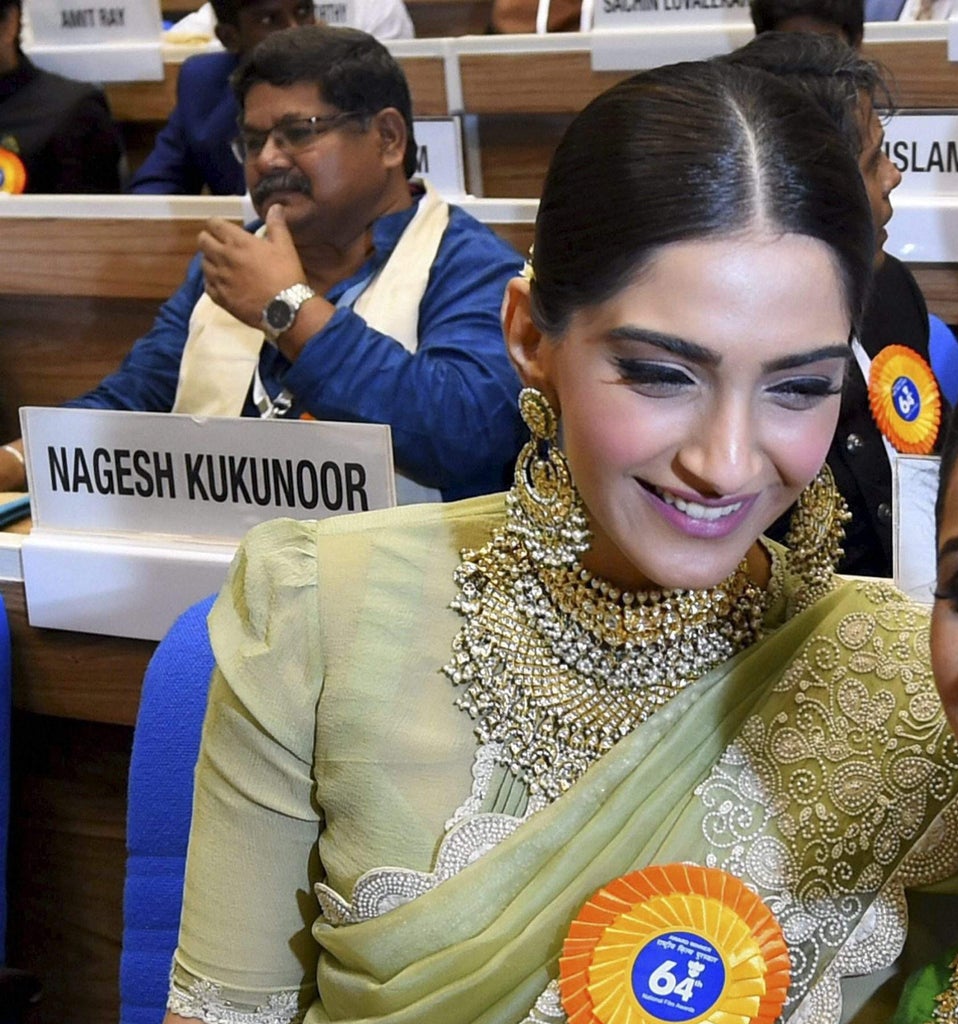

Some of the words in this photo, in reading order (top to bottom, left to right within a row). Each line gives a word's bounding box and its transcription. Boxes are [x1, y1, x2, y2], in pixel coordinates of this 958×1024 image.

[61, 9, 95, 29] AMIT
[98, 8, 125, 27] RAY
[47, 446, 177, 499] NAGESH
[184, 453, 370, 512] KUKUNOOR
